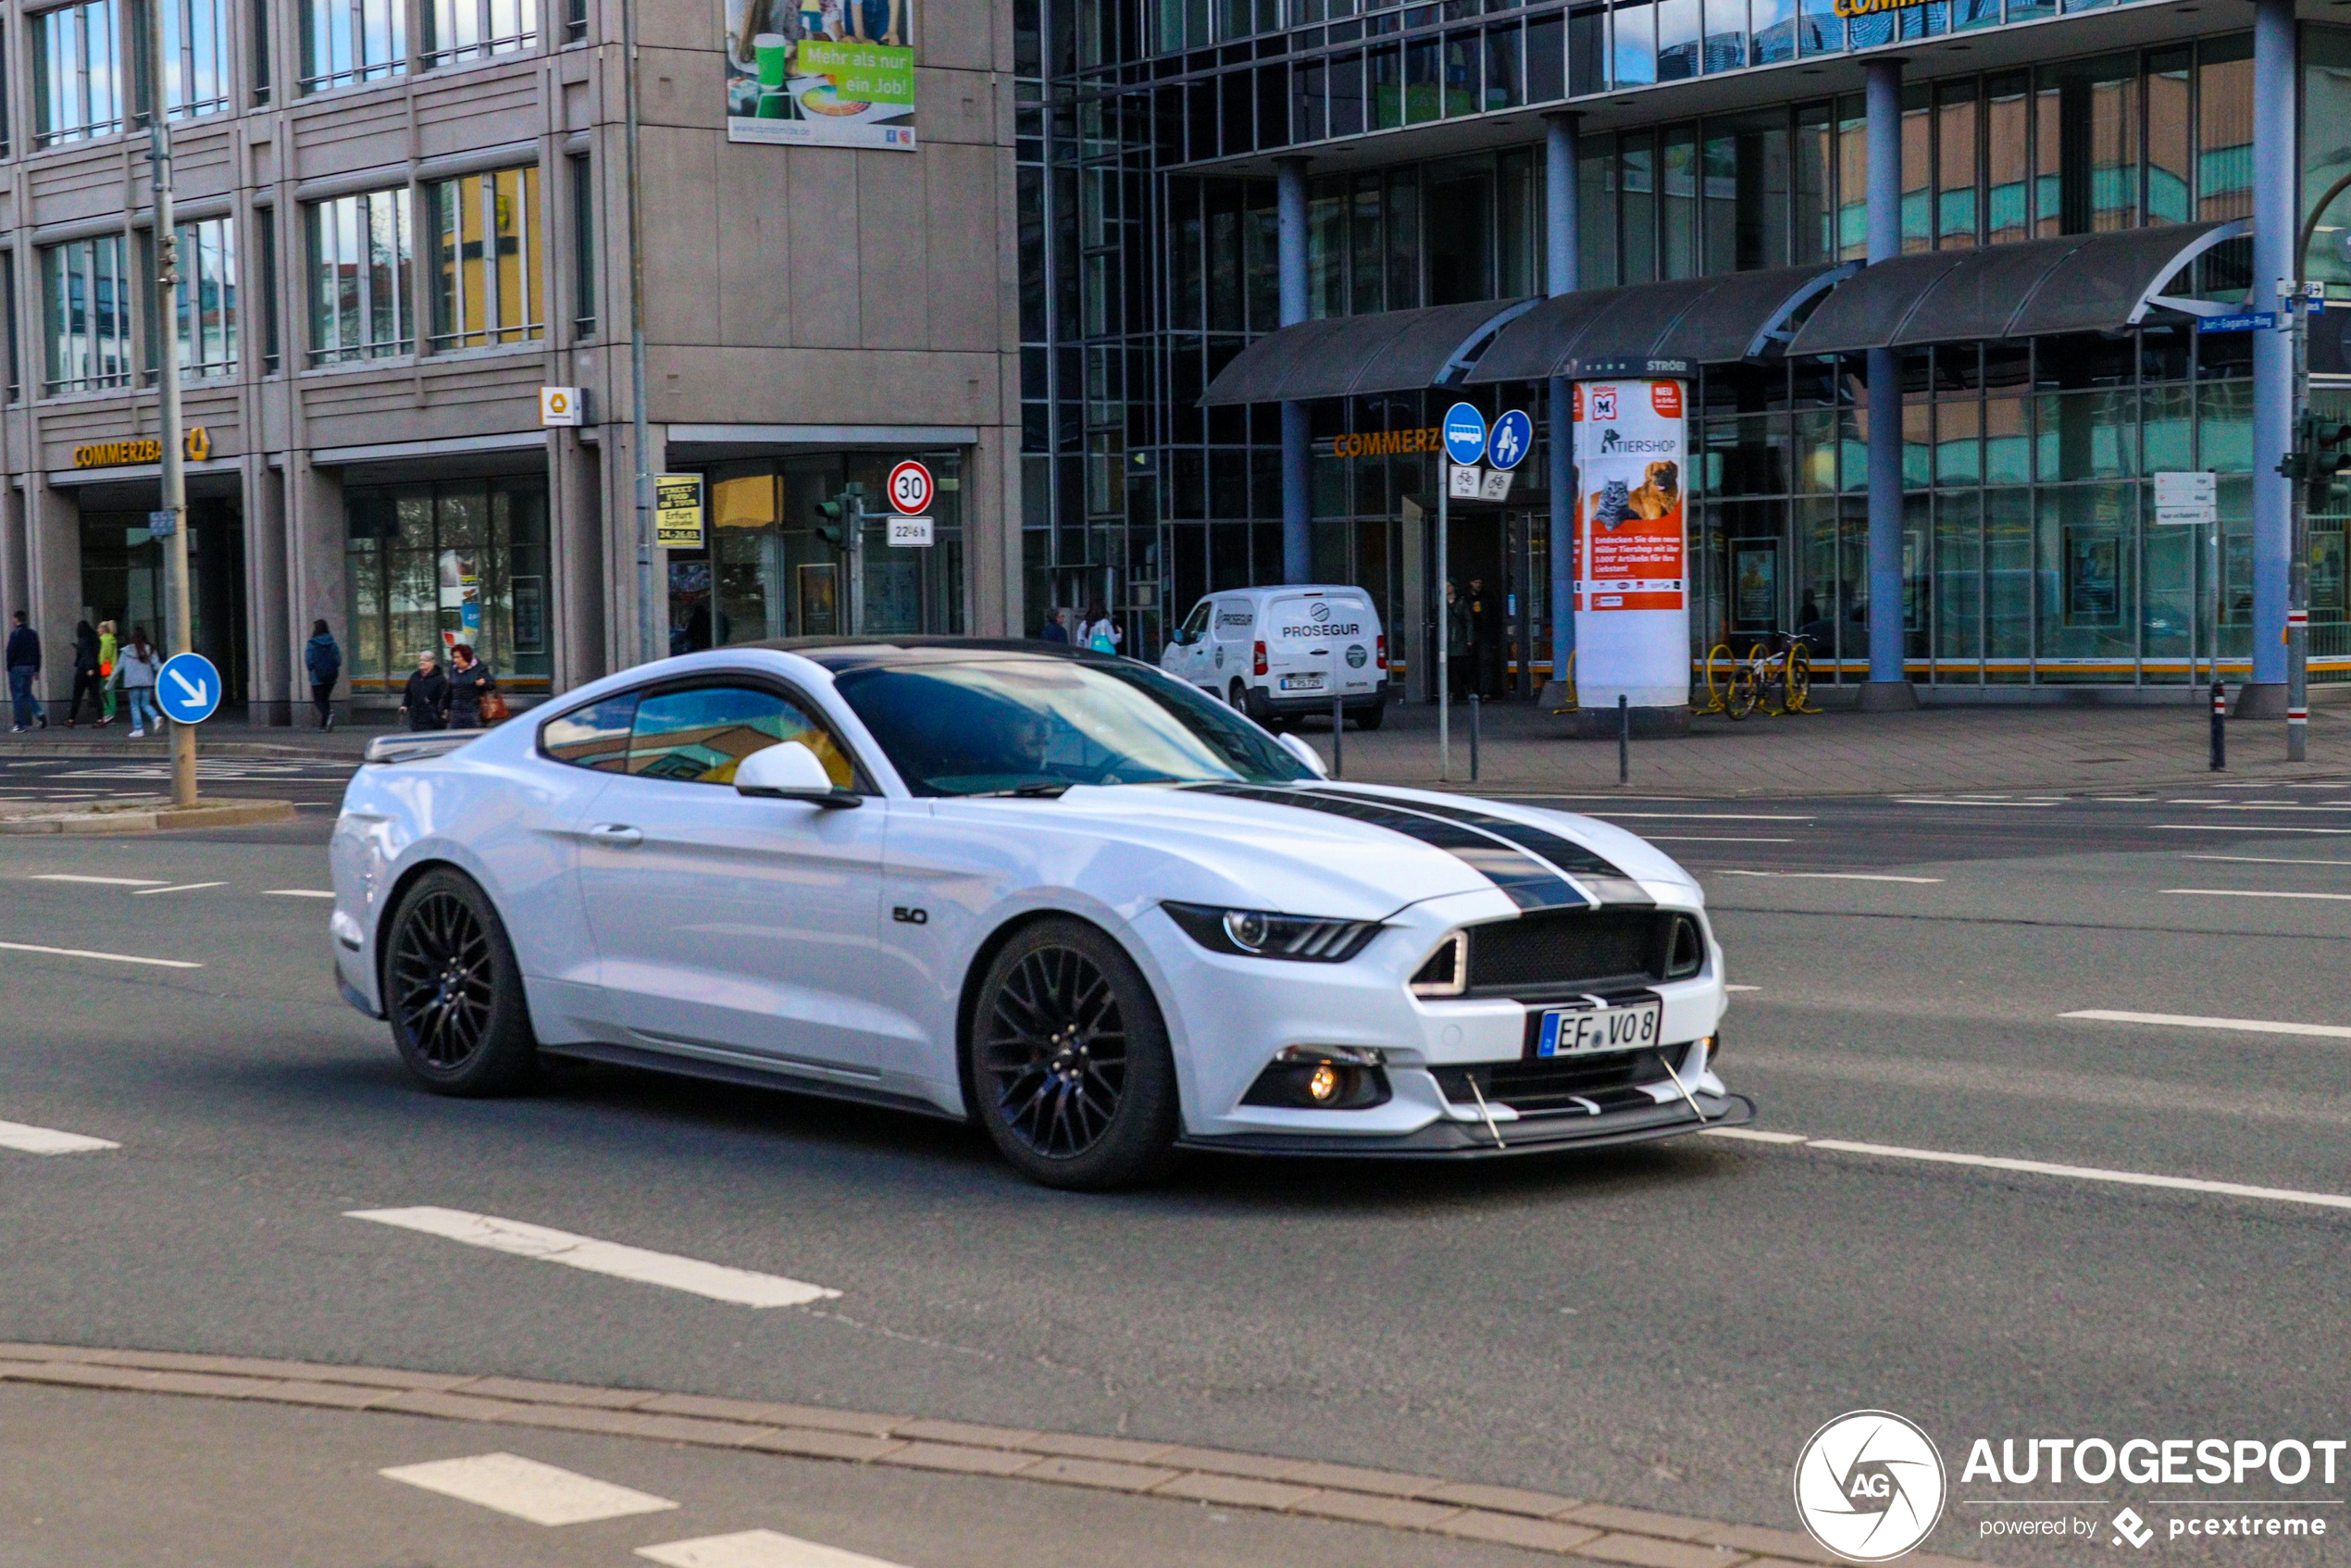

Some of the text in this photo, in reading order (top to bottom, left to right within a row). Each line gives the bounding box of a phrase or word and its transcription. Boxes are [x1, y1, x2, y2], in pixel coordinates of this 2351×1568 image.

[807, 47, 907, 69] Mehr als nur
[845, 78, 907, 95] ein Job!
[2202, 316, 2271, 330] Juri-Gagarin-Ring
[1647, 359, 1687, 371] STRÖER
[1655, 386, 1673, 396] NEU
[1597, 400, 1611, 413] M
[73, 439, 163, 467] COMMERZBA
[1616, 440, 1676, 454] TIERSHOP
[898, 476, 923, 500] 30
[666, 492, 690, 501] FOOD
[665, 511, 692, 520] Erfurt
[895, 526, 926, 538] 22-6 h
[1595, 536, 1633, 544] Entdecken
[1634, 535, 1647, 544] Sie
[1648, 535, 1662, 543] den
[1618, 544, 1653, 554] Tiershop
[1223, 613, 1253, 626] PROSEGUR
[1282, 624, 1360, 638] PROSEGUR
[892, 906, 928, 925] 5.0
[1558, 1011, 1654, 1049] EF VO 8
